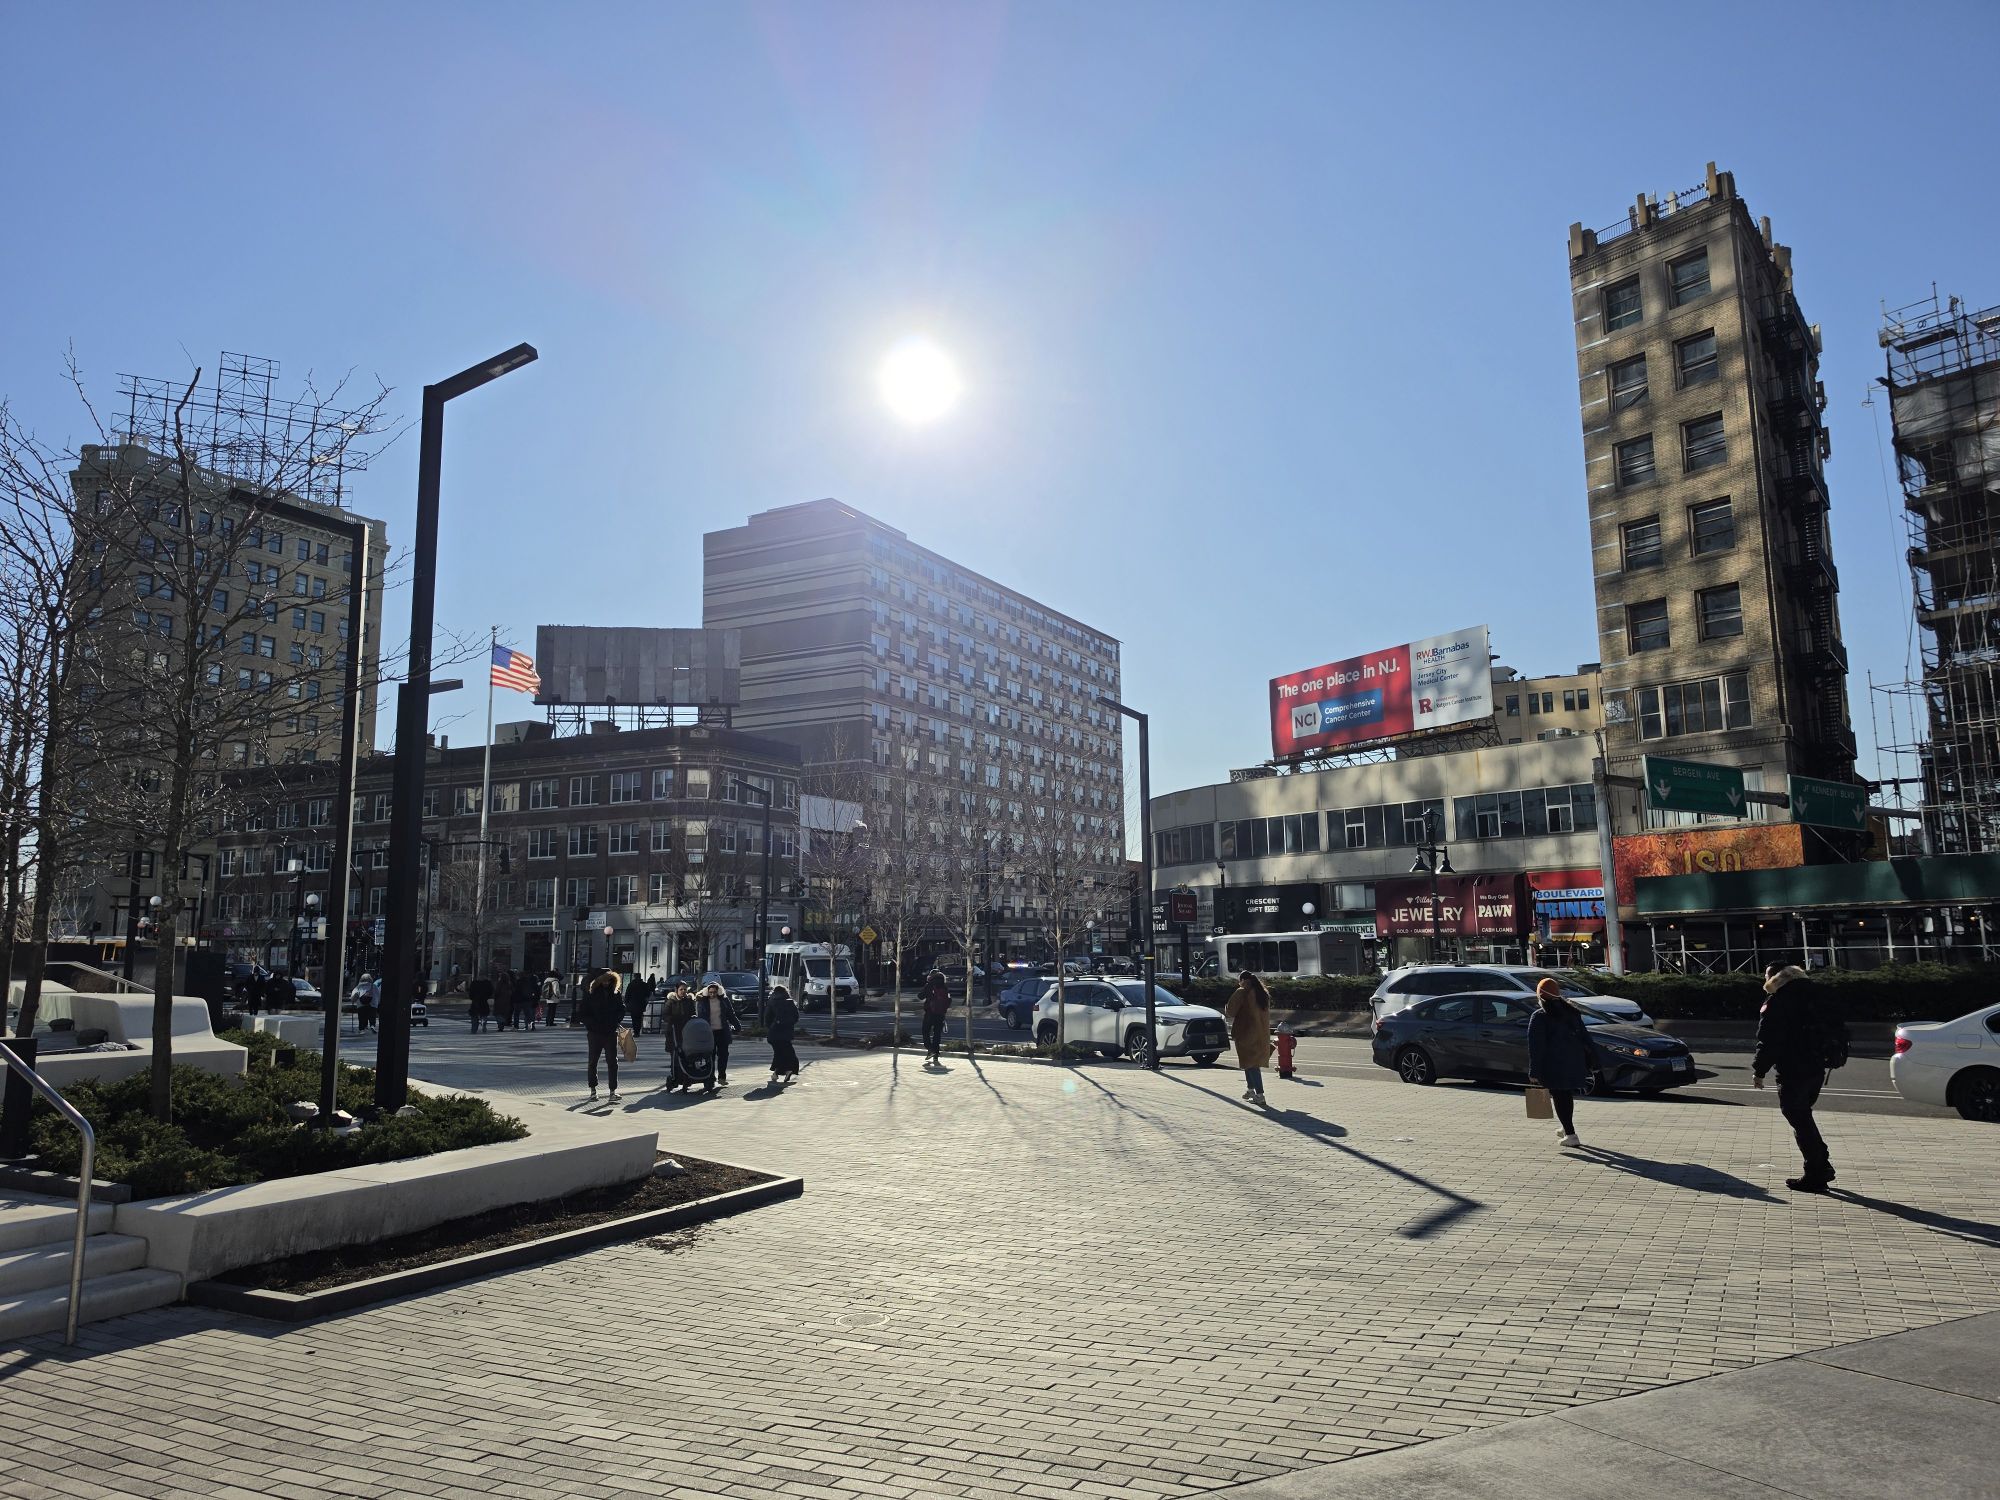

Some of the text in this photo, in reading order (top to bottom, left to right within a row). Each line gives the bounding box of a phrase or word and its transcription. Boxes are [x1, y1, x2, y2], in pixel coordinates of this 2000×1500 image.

[1423, 655, 1446, 664] HEALTH
[1277, 658, 1400, 698] The one place in NJ.
[1417, 668, 1447, 680] Jersey City
[1417, 673, 1459, 686] Medical Center
[1324, 698, 1376, 715] Comprehensive
[1419, 698, 1433, 714] R
[1294, 712, 1317, 729] NCI
[1324, 709, 1372, 724] Cancer Center
[1672, 766, 1721, 781] BERGEN AVE
[1812, 785, 1837, 797] KENNEDY
[1840, 789, 1855, 800] BLVD
[1414, 895, 1433, 906] Villag
[1536, 888, 1603, 899] BOULEVARD
[1478, 905, 1513, 918] PAWN
